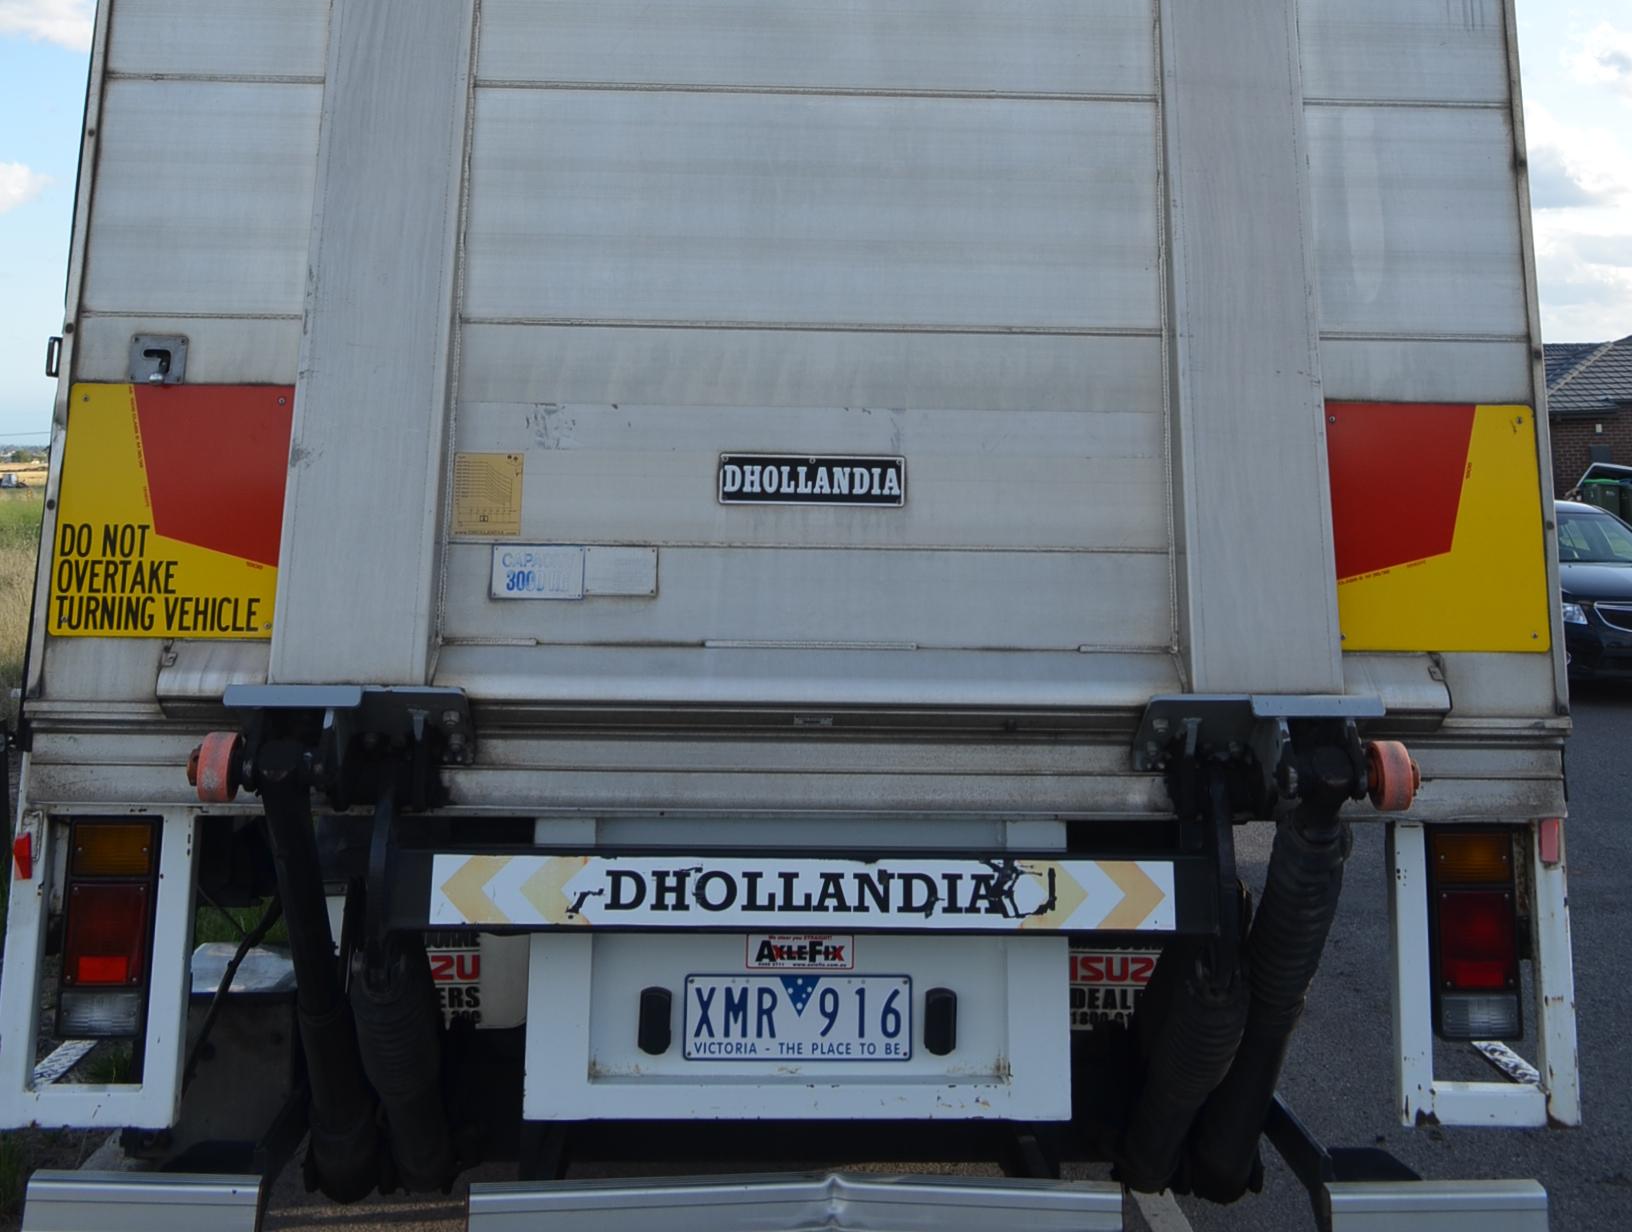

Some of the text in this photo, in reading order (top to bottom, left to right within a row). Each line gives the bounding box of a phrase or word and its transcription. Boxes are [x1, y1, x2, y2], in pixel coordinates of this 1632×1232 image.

[723, 465, 901, 495] DHOLLANDIA
[60, 523, 150, 558] DO NOT
[57, 559, 179, 594] OVERTAKE
[55, 595, 261, 632] TURNING VEHICLE
[604, 869, 1003, 917] DHOLLANDIA
[694, 986, 902, 1039] XMR 916
[694, 1041, 757, 1055] VICTORIA
[778, 1042, 803, 1055] THE
[811, 1043, 852, 1055] PLACE
[859, 1043, 876, 1055] TO
[885, 1043, 901, 1056] BE
